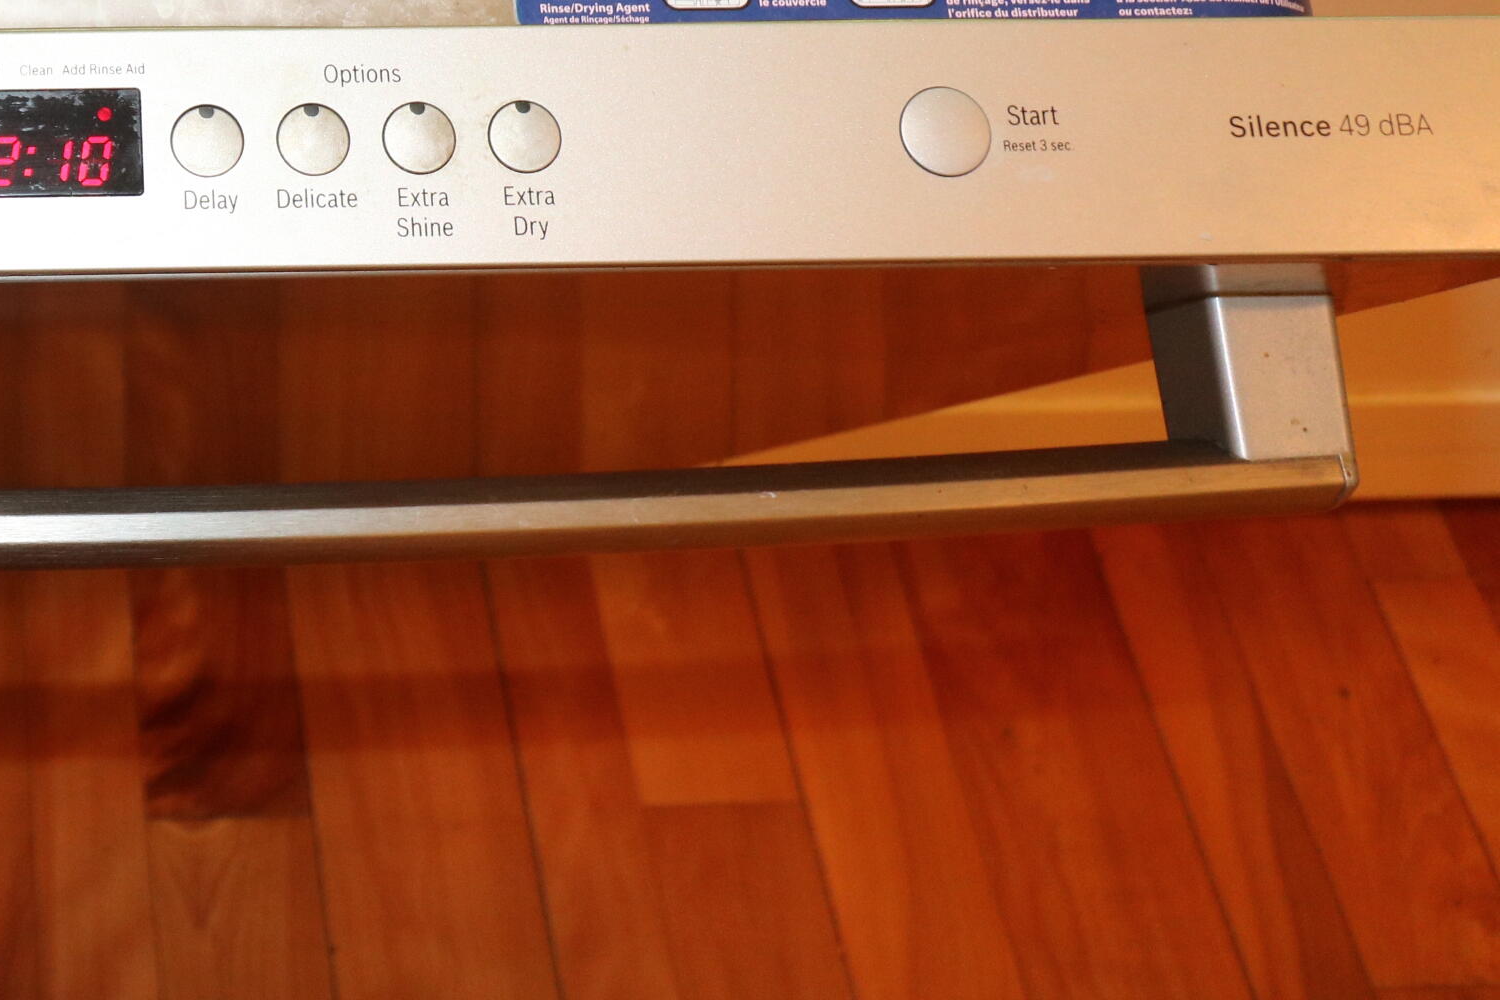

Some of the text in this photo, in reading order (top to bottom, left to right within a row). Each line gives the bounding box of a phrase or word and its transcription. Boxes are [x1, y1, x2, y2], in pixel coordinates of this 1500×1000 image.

[540, 2, 651, 15] Rinse/Drying Agent
[948, 7, 1078, 18] l'orifice du distributeur
[1119, 7, 1193, 16] ou contactez:
[544, 15, 569, 24] Agent
[569, 16, 579, 24] de
[20, 65, 53, 76] Clean
[62, 64, 85, 75] Add
[89, 64, 123, 75] Rinse
[126, 63, 145, 75] Aid
[323, 64, 401, 87] Options
[1007, 104, 1060, 126] Start
[1229, 113, 1434, 138] Silence 49 dBA
[1003, 140, 1036, 151] Reset
[1040, 139, 1047, 151] 3
[184, 190, 238, 213] Delay
[277, 188, 358, 209] Delicate
[397, 187, 449, 207] Extra
[504, 185, 555, 206] Extra
[397, 217, 454, 238] Shine
[514, 216, 549, 240] Dry
